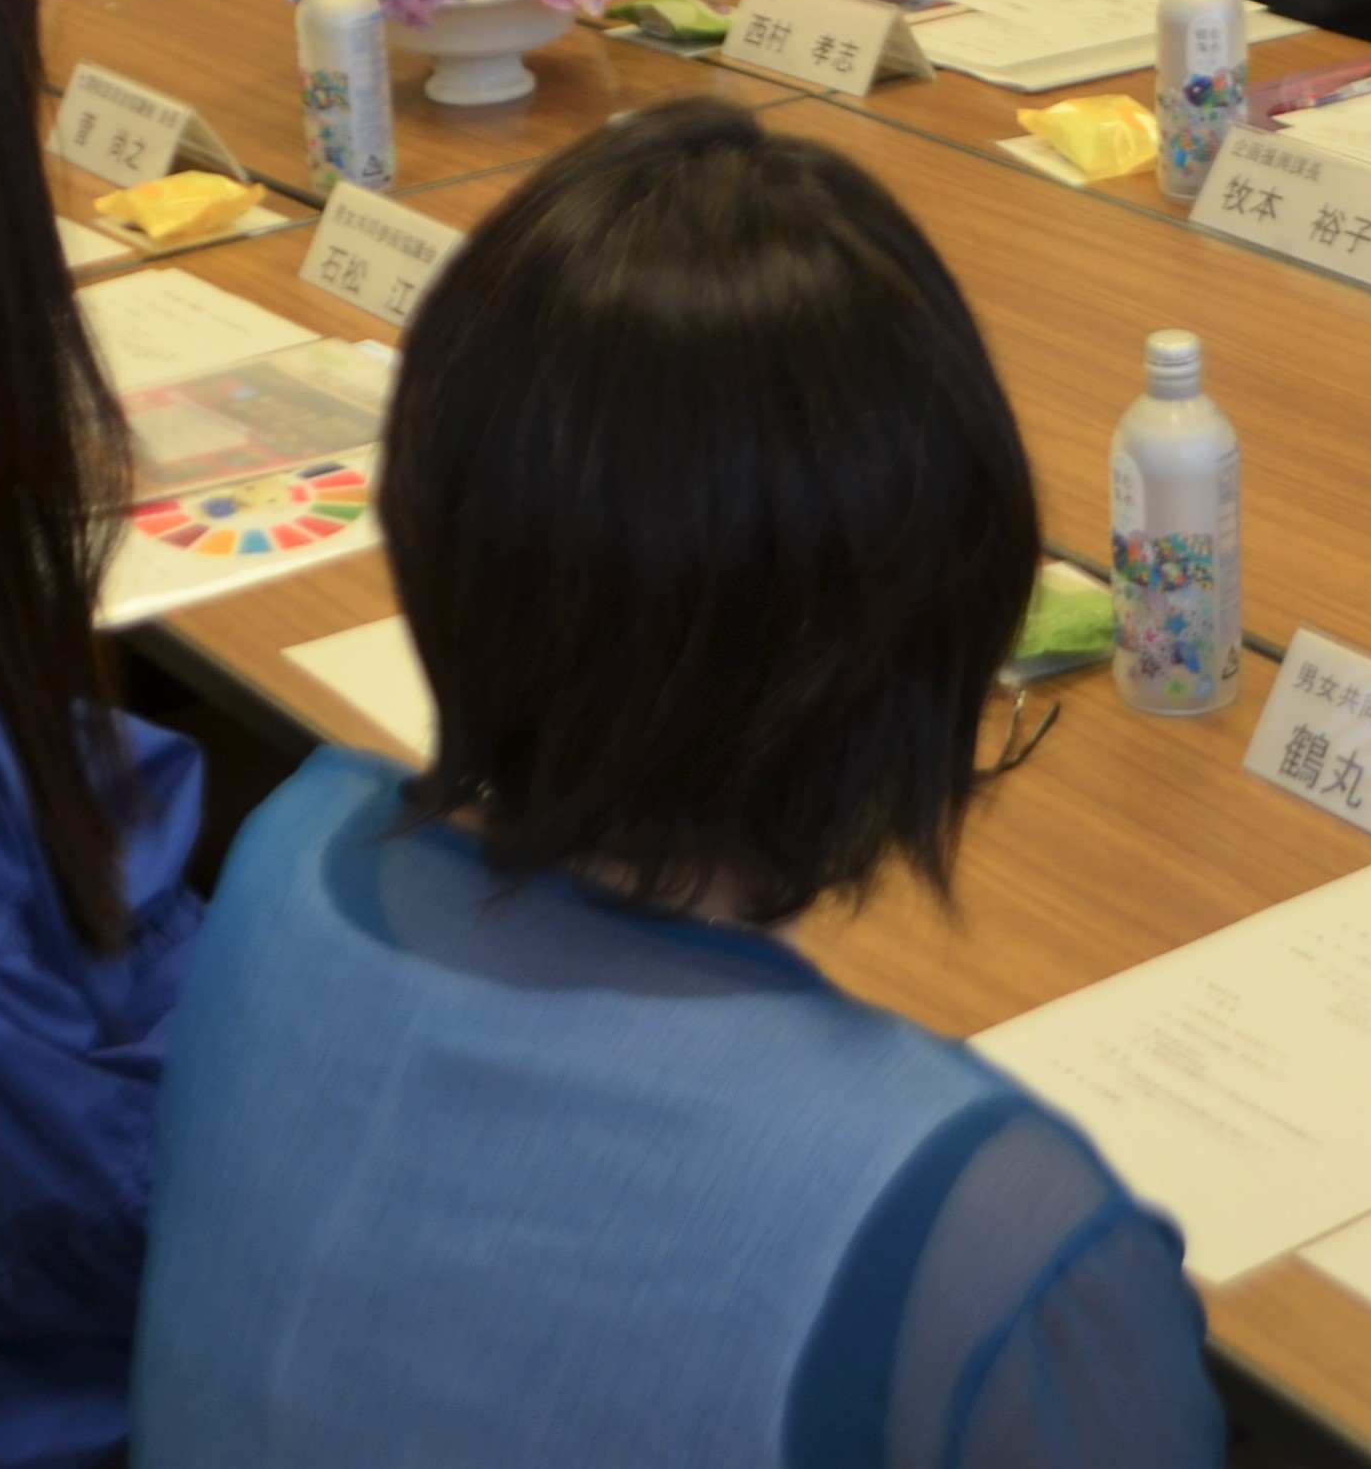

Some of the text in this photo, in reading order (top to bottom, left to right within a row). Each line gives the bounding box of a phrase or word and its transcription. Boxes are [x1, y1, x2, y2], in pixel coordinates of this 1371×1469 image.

[743, 13, 791, 53] 西村
[1222, 173, 1284, 222] 牧本
[320, 245, 369, 295] 石松
[1278, 722, 1367, 811] 鶴丸
